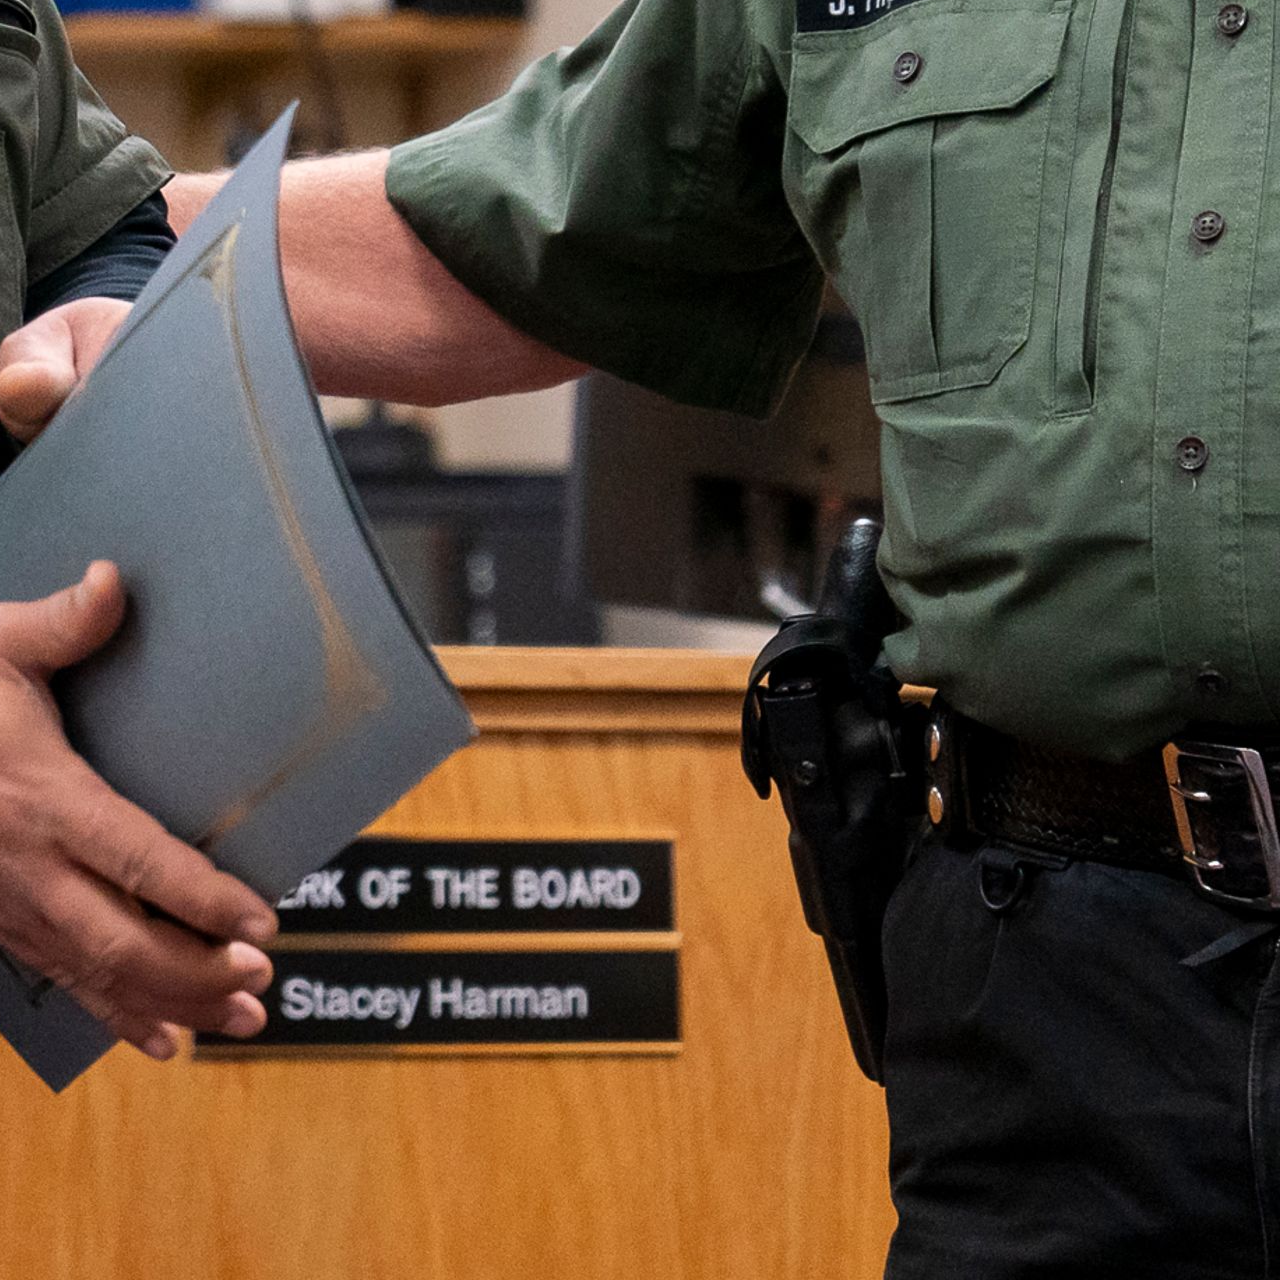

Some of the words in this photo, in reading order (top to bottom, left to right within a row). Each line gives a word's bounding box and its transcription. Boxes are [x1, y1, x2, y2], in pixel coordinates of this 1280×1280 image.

[358, 868, 411, 909] OF
[426, 868, 501, 909] THE
[512, 868, 642, 909] BOARD
[281, 977, 420, 1029] Stacey
[429, 977, 589, 1019] Harman
